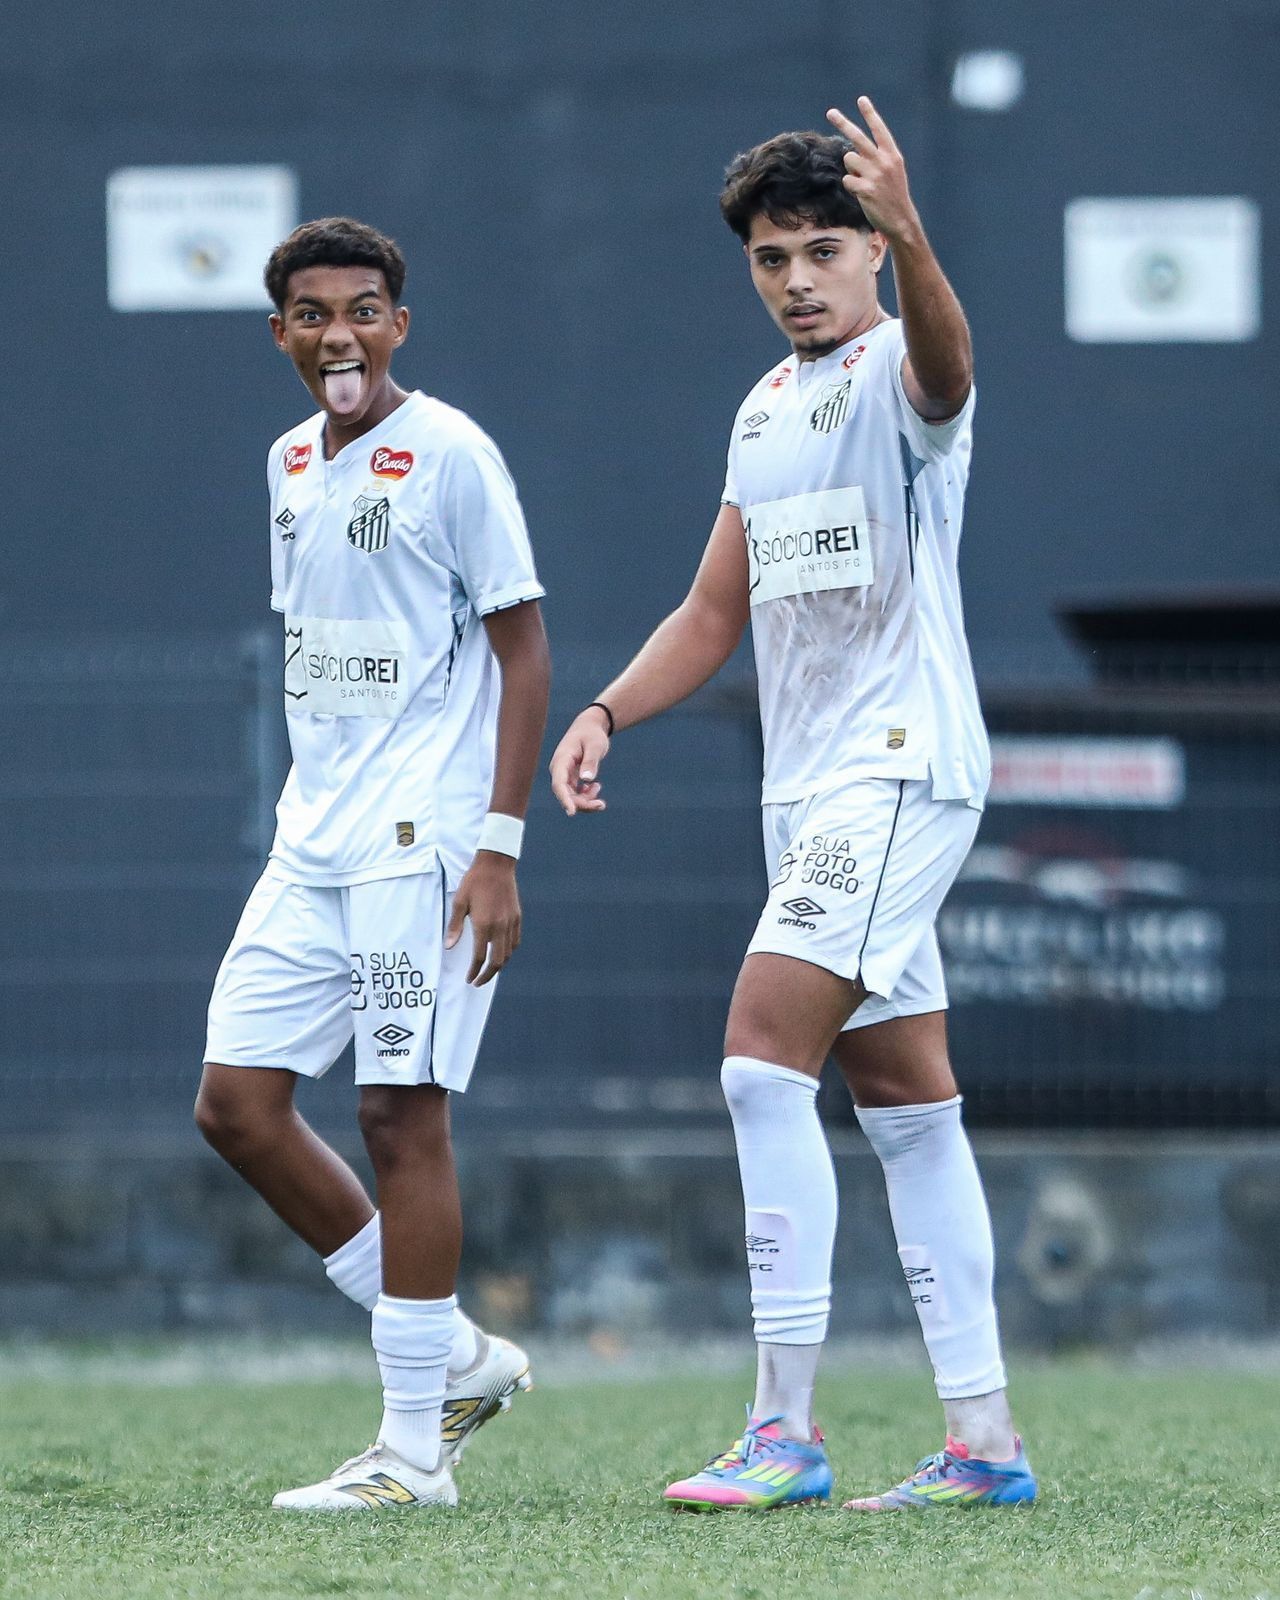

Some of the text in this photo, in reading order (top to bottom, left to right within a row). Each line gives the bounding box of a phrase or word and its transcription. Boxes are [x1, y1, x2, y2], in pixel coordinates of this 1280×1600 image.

[373, 450, 411, 472] Canção
[800, 560, 839, 573] ANTOS
[384, 690, 397, 700] FC
[810, 835, 850, 855] SUA
[803, 852, 857, 874] FOTO
[801, 868, 859, 894] JOGO
[777, 917, 816, 931] umbro
[369, 951, 412, 971] SUA
[371, 970, 424, 991] FOTO
[378, 989, 433, 1010] JOGO
[376, 1047, 410, 1058] umbro
